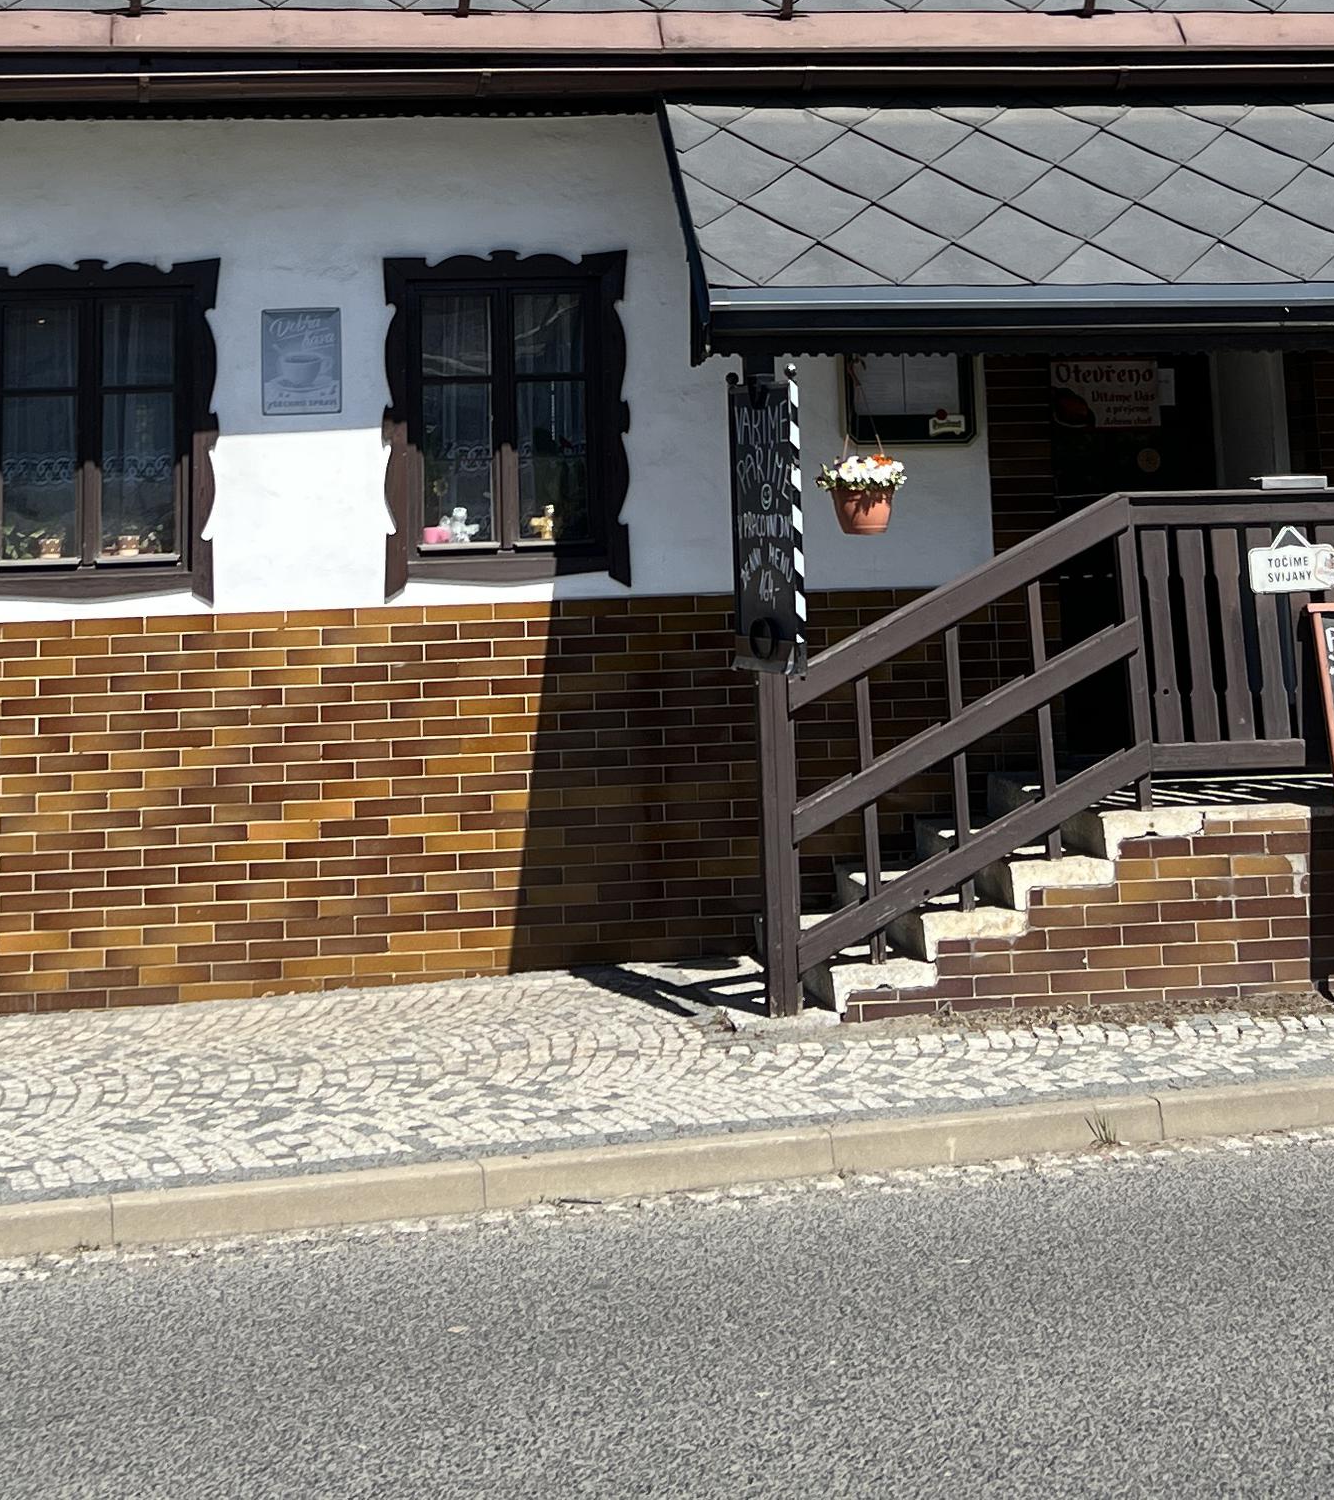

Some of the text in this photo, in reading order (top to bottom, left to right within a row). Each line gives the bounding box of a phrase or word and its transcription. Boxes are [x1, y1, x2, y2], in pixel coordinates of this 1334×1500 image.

[1055, 363, 1154, 386] Otevřeno
[768, 542, 794, 583] MENU
[1267, 555, 1309, 568] TOČÍME
[1267, 570, 1312, 583] SVIJANY
